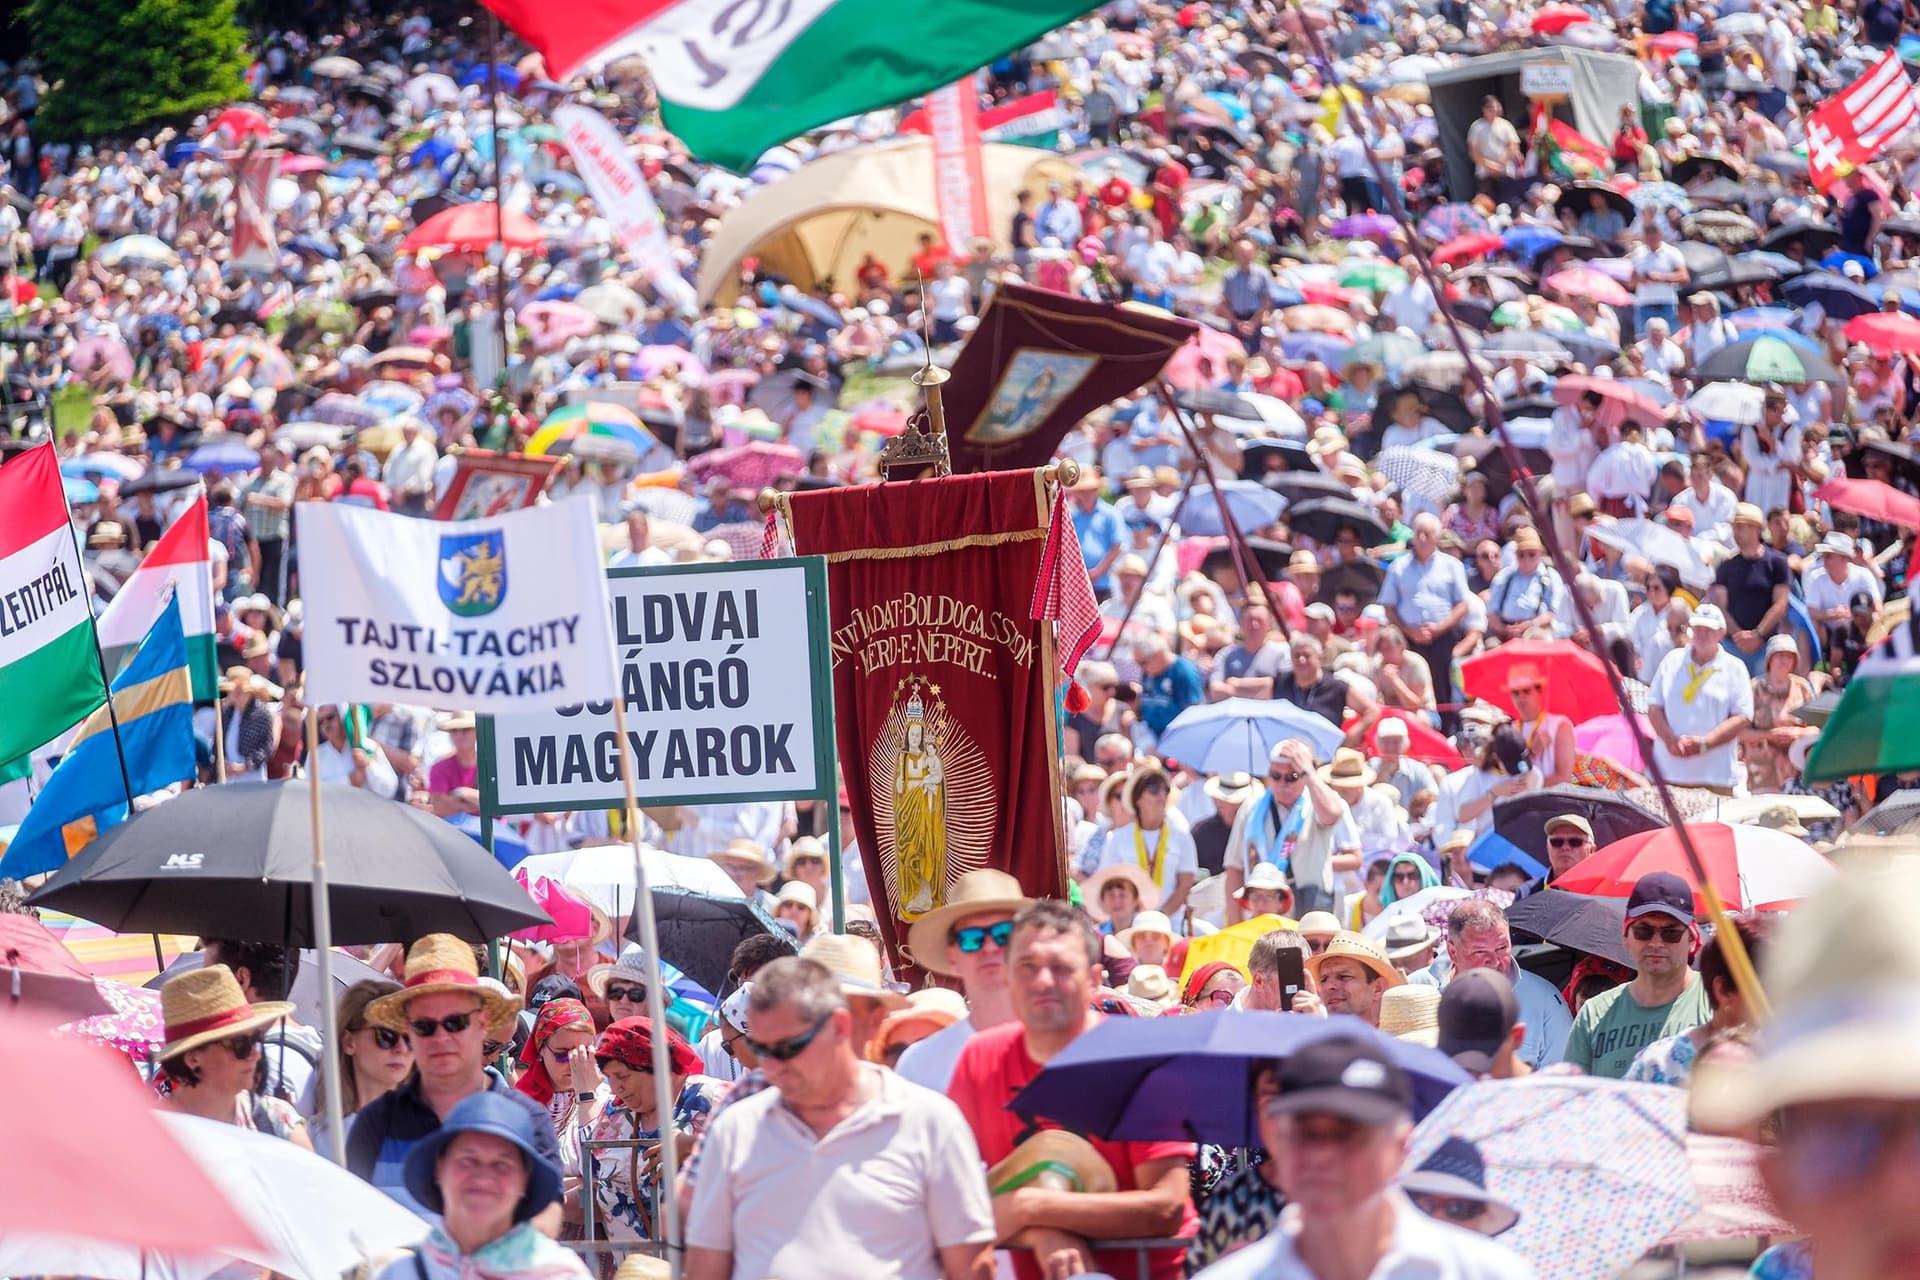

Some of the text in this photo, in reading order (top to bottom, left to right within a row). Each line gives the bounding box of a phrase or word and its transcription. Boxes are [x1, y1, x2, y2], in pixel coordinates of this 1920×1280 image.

[336, 614, 580, 657] TAJTI-TACHTY
[611, 589, 760, 644] LDVAI
[370, 659, 565, 696] SZLOVÁKIA
[555, 644, 750, 717] ÁNGÓ
[514, 723, 797, 786] MAGYAROK
[1594, 1021, 1696, 1059] ORIGINAL
